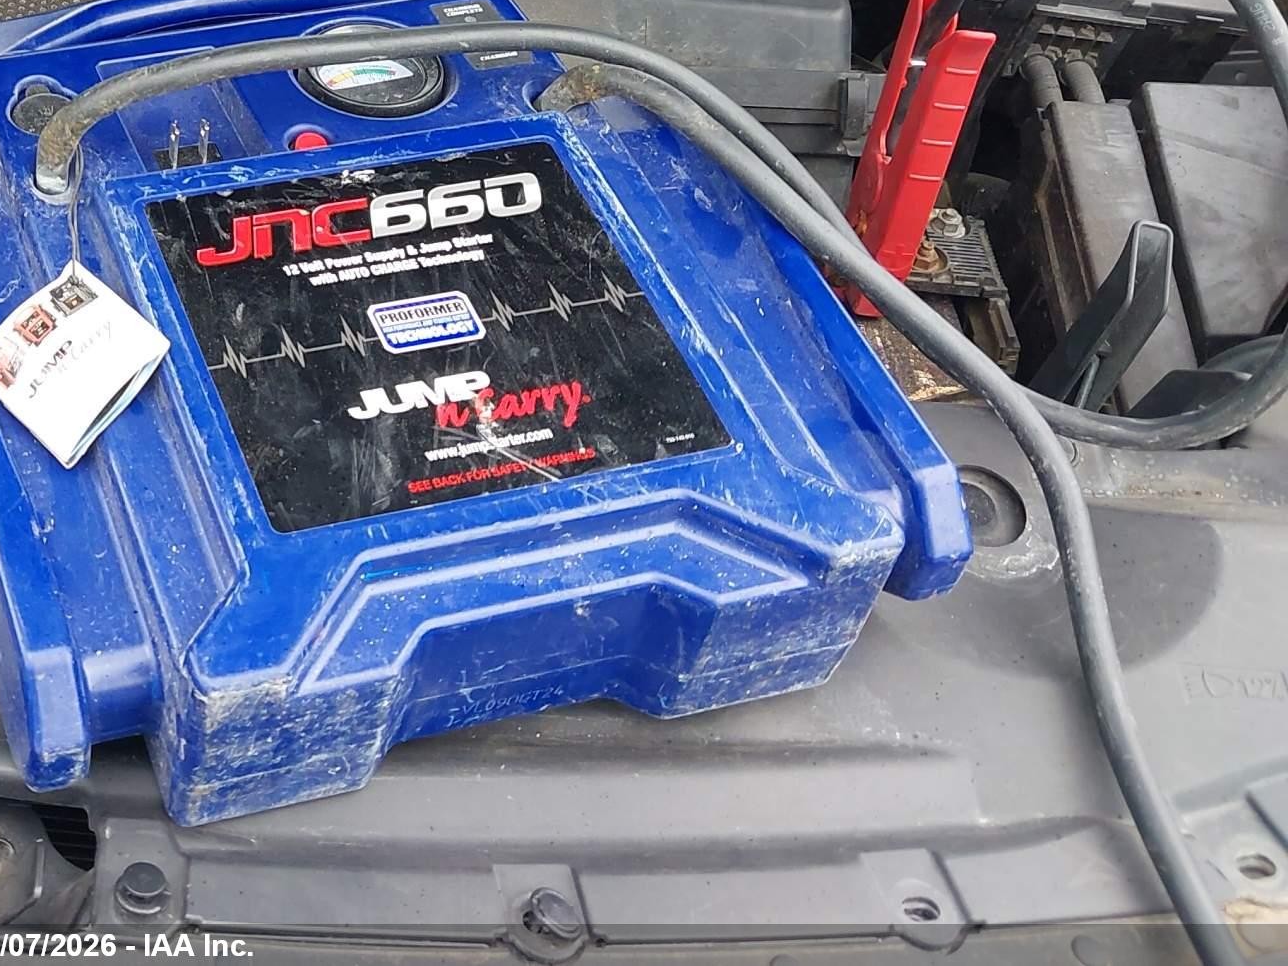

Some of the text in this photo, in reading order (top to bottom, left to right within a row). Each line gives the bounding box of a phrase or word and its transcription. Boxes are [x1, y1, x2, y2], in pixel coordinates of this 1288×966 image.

[197, 172, 543, 267] JNC660
[282, 234, 493, 277] 12 Volt Power Supply & Jump Starter
[309, 249, 484, 286] with AUTO CHARGE Technology
[379, 301, 464, 324] PROFORMER
[386, 320, 476, 344] TECHNOLOGY
[348, 371, 490, 420] JUMP
[436, 401, 470, 428] n
[408, 477, 433, 494] SEE
[434, 472, 464, 490] BACK
[465, 468, 490, 484] FOR
[534, 447, 596, 469] WARNINGS
